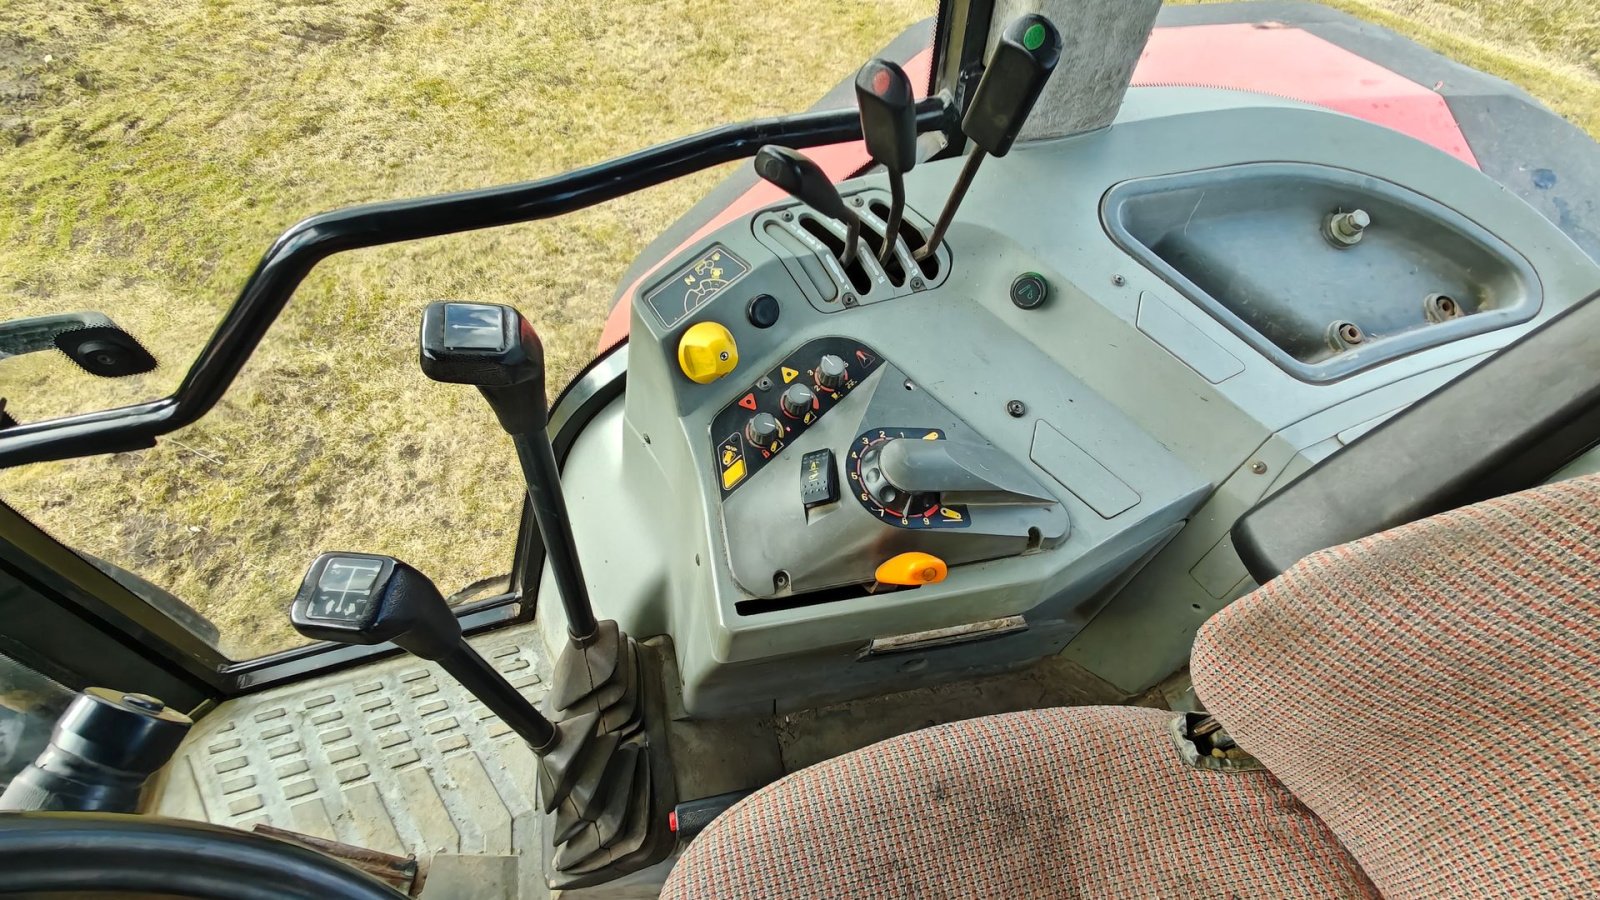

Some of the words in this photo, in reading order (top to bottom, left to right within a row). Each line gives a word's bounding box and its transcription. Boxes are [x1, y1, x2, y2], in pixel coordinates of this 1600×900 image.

[879, 430, 886, 438] 2
[862, 437, 869, 445] 3
[851, 451, 858, 459] 4
[851, 472, 858, 480] 5
[861, 493, 868, 501] 6
[922, 517, 930, 525] 9
